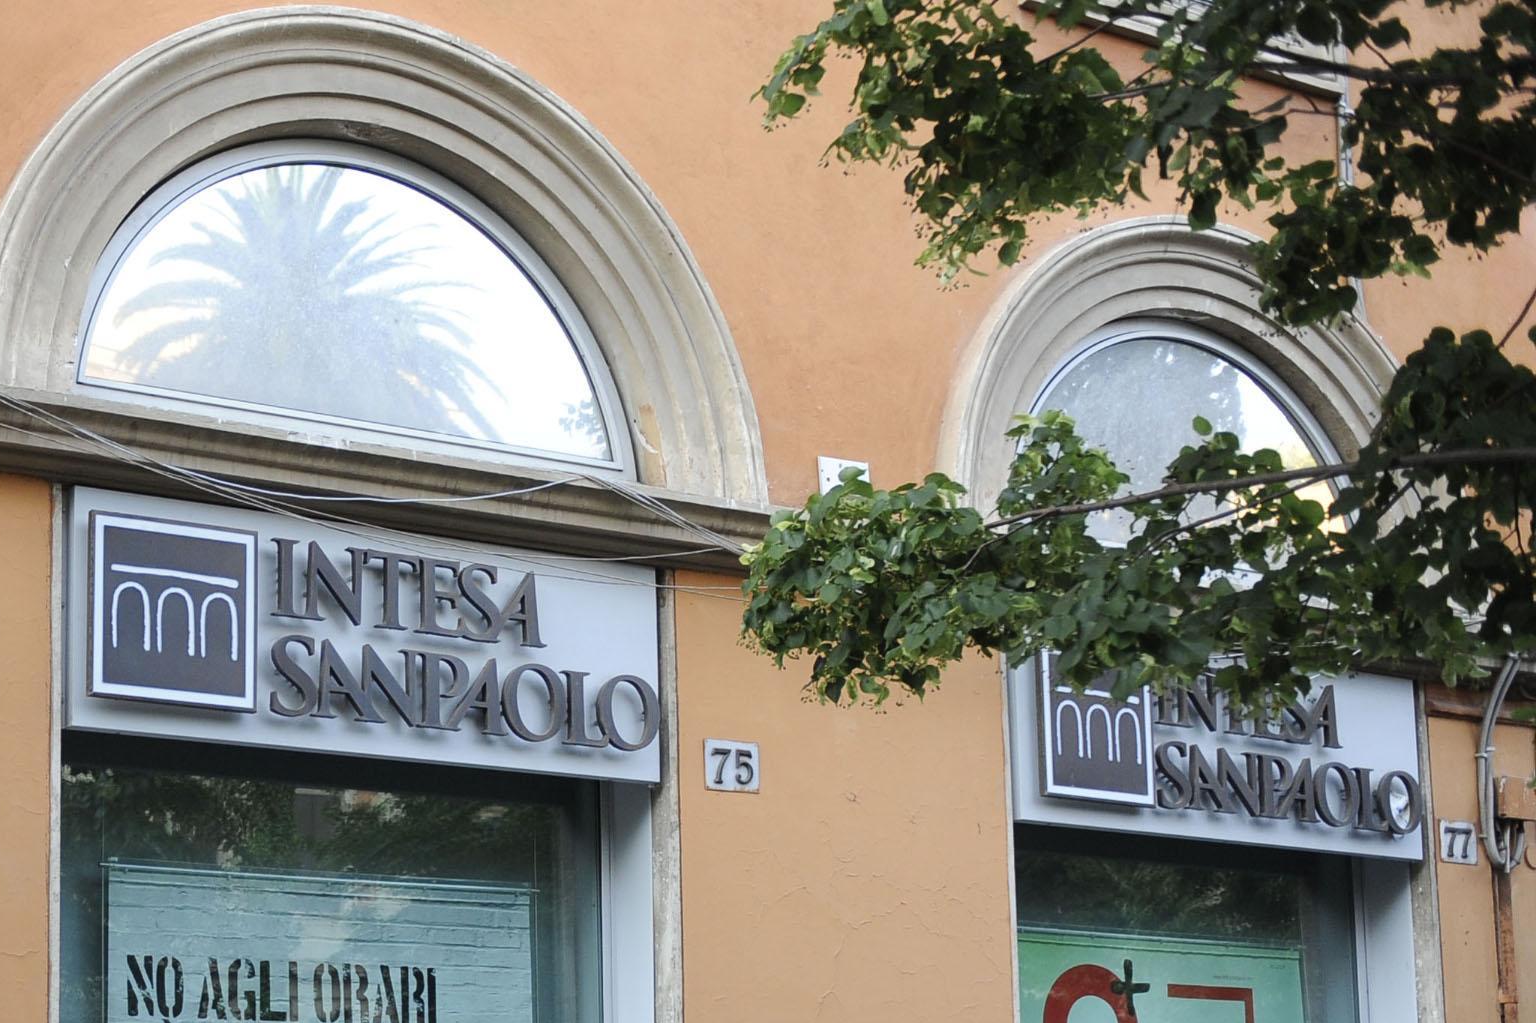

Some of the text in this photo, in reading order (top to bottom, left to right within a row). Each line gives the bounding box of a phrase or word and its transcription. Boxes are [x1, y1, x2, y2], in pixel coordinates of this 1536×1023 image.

[269, 537, 548, 648] INTESA
[269, 634, 661, 752] SANPAOLO
[711, 747, 754, 785] 75
[1154, 741, 1423, 835] SANPAOLO
[1444, 826, 1473, 859] 77
[126, 954, 184, 1018] NO
[197, 957, 299, 1022] AGLI
